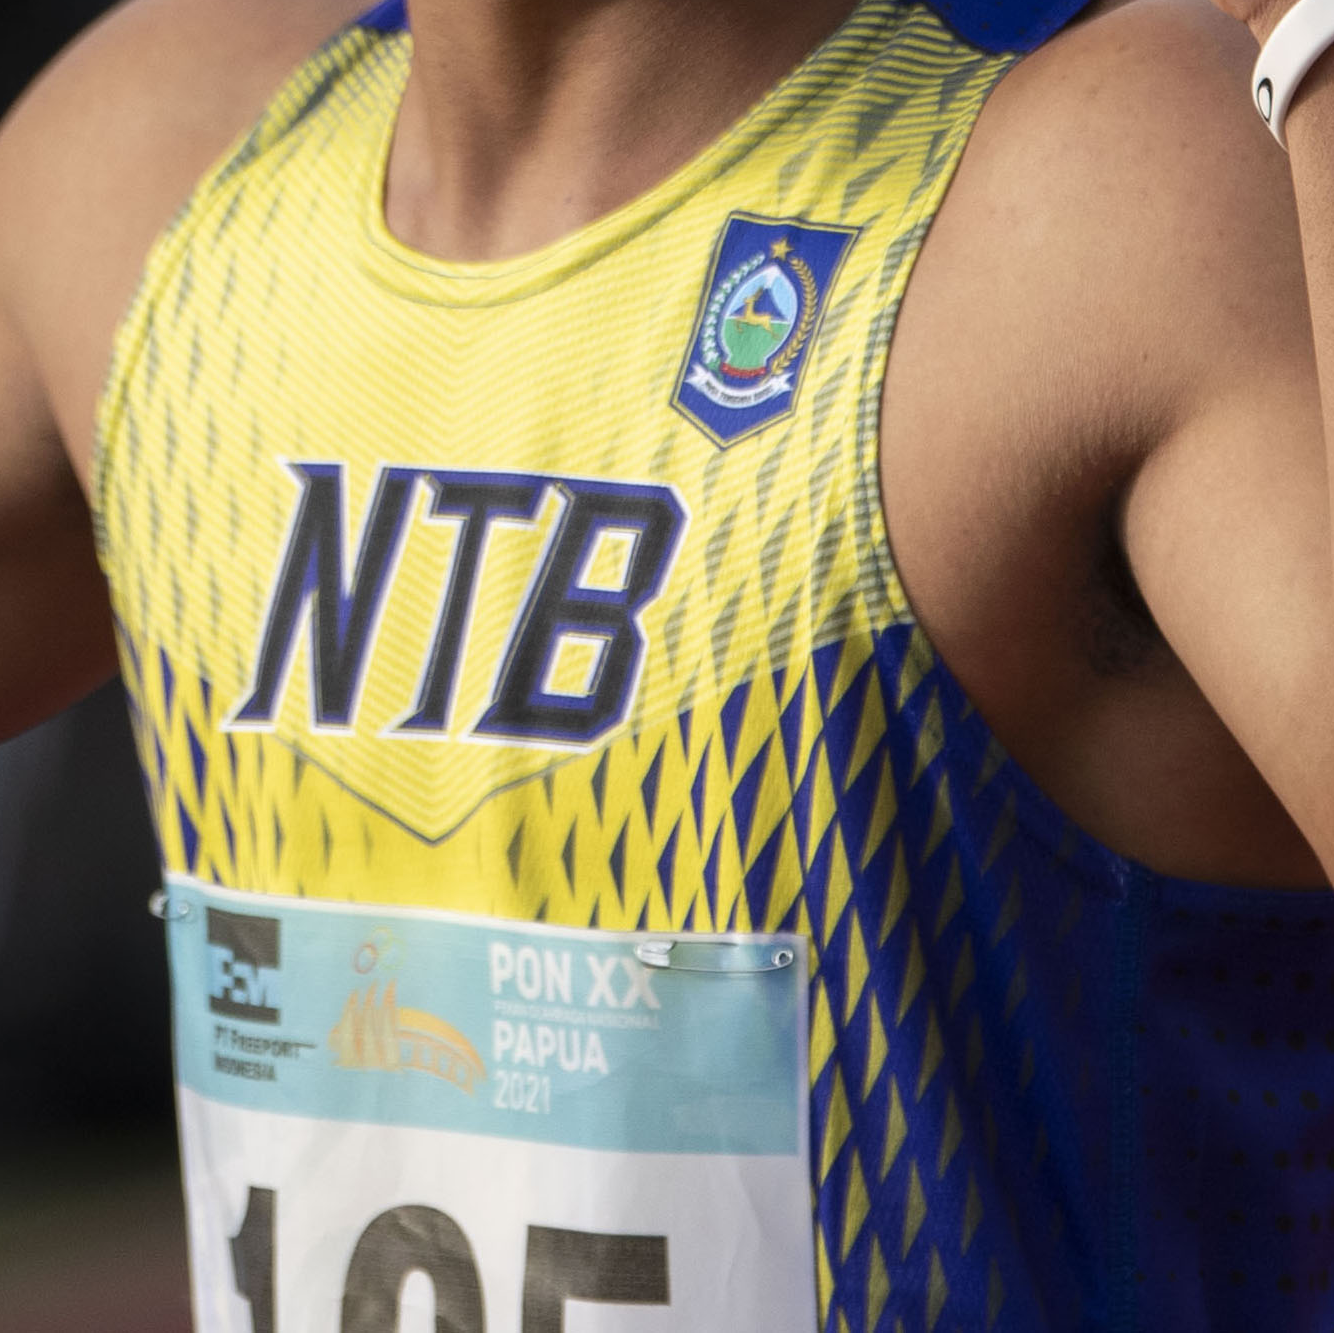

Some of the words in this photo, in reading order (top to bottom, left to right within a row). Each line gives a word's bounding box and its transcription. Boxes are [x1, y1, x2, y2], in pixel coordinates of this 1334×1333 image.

[221, 456, 690, 753] NTB
[489, 941, 572, 1004] PON
[586, 952, 661, 1009] XX
[493, 1019, 610, 1075] PAPUA
[494, 1069, 551, 1115] 2021
